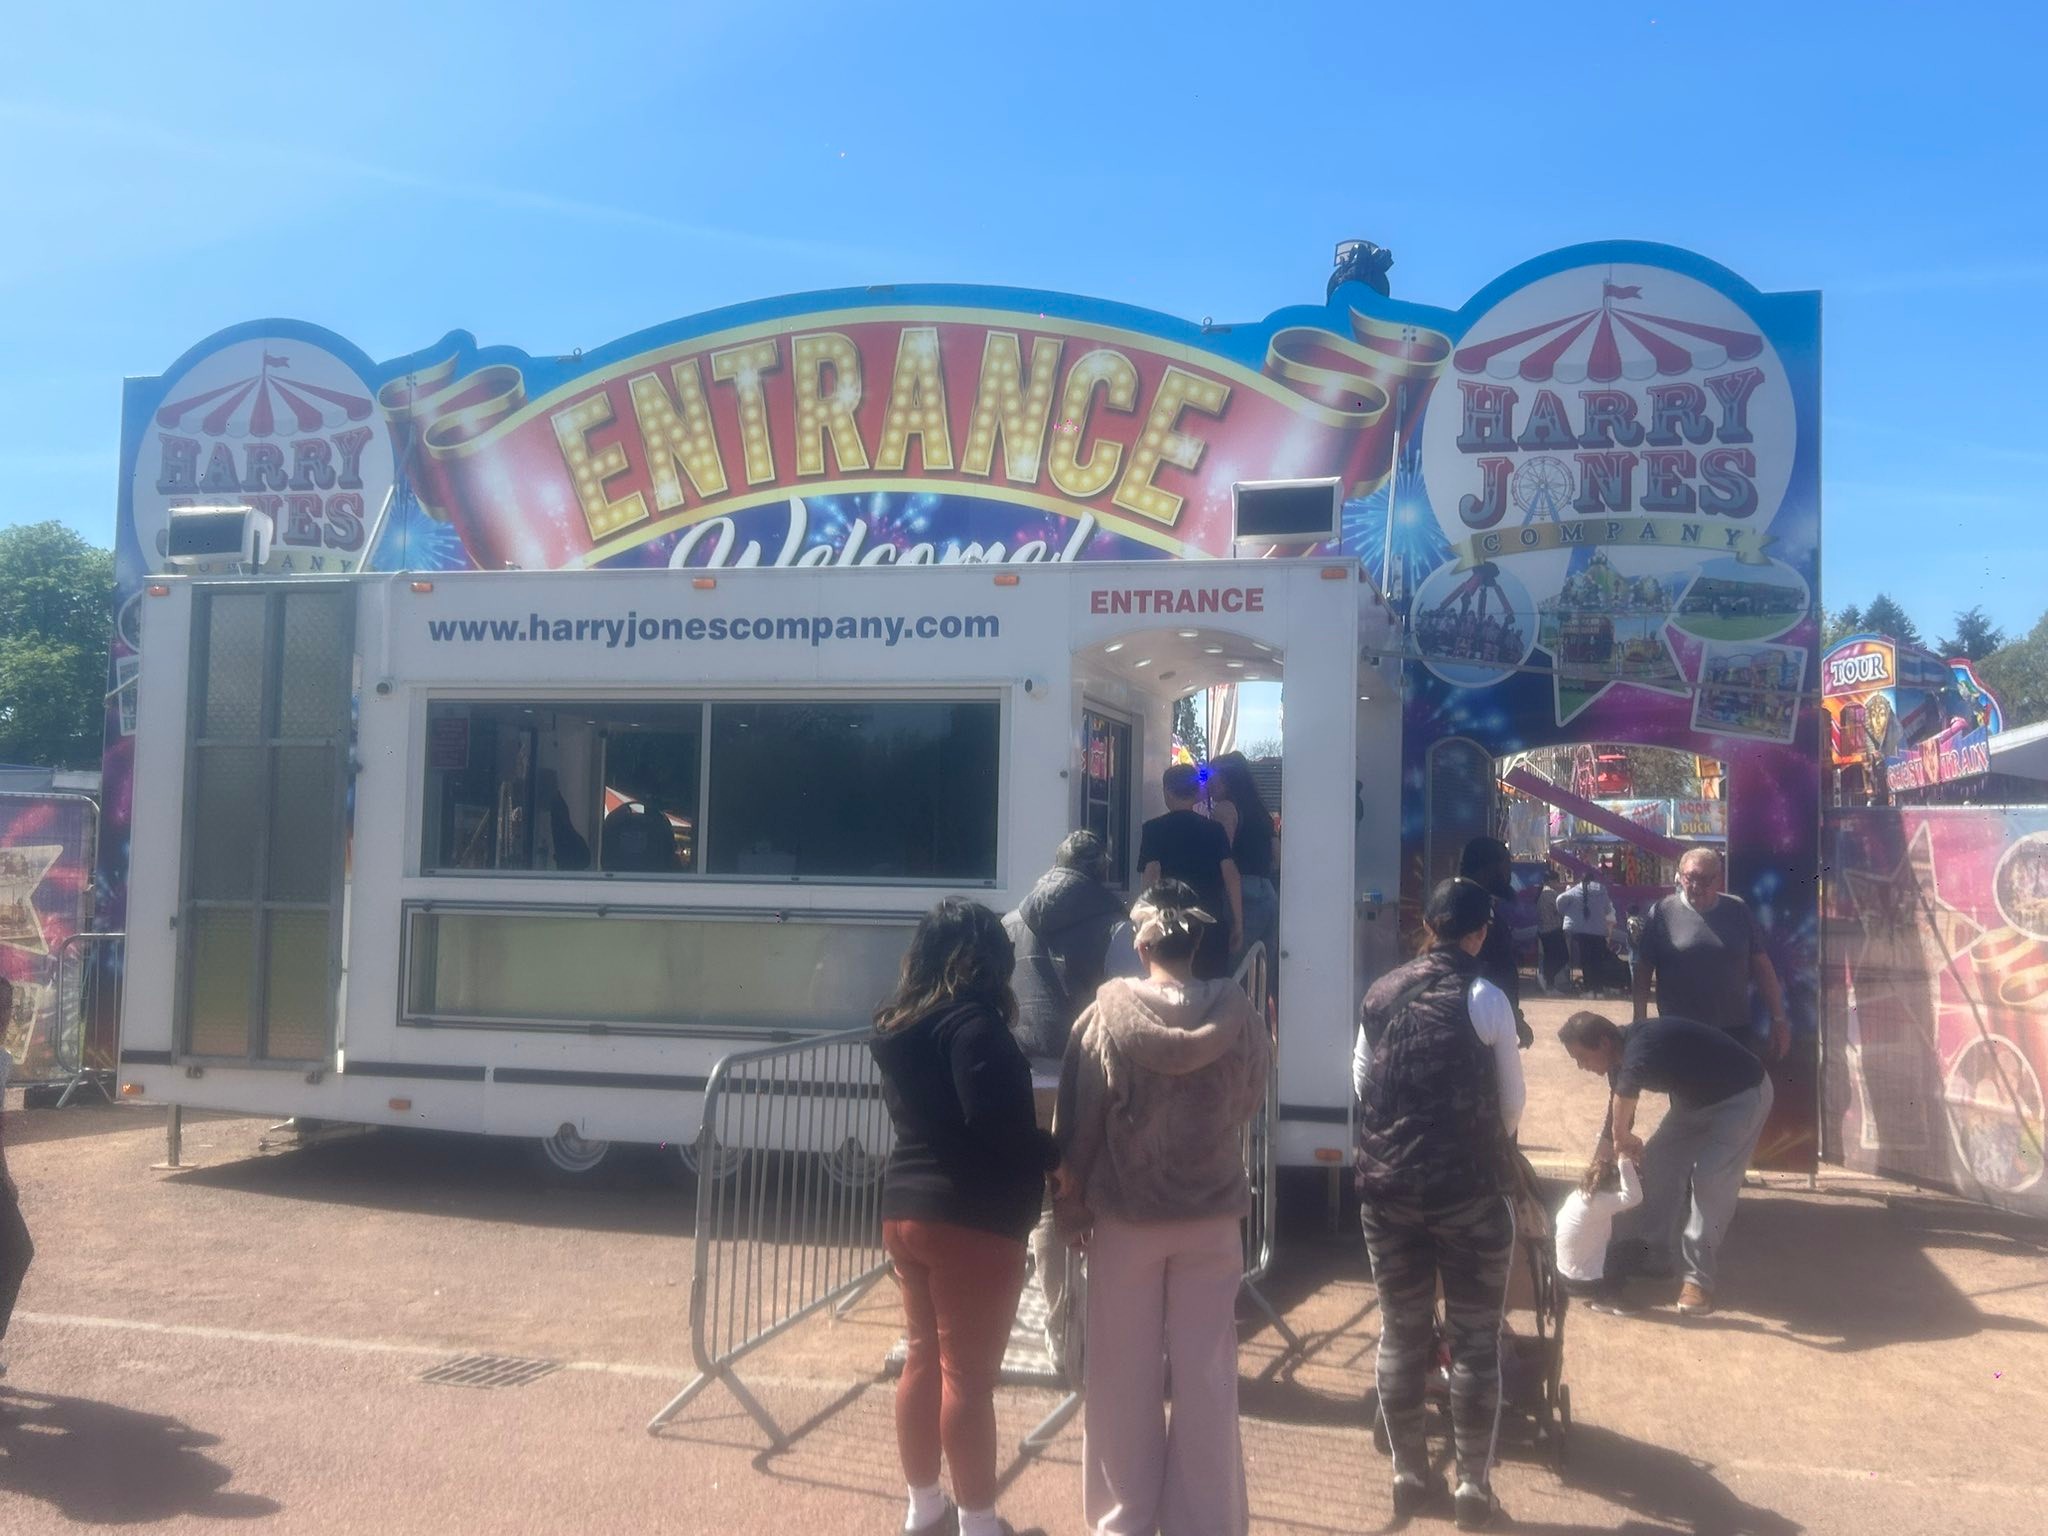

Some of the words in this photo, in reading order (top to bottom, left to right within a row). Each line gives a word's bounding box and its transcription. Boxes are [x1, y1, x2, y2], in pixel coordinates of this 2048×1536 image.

[1456, 367, 1765, 453] HARRY
[551, 327, 1231, 541] ENTRANCE
[156, 426, 373, 495] HARRY
[156, 492, 366, 553] NES
[1481, 521, 1745, 552] COMPANY
[1090, 588, 1265, 614] ENTRANCE
[428, 611, 1000, 649] www.harryjonescompany.com
[1831, 654, 1888, 686] TOUR
[1939, 742, 1989, 783] TRAIN
[1679, 802, 1711, 814] HOOK
[1681, 822, 1712, 834] DUCK
